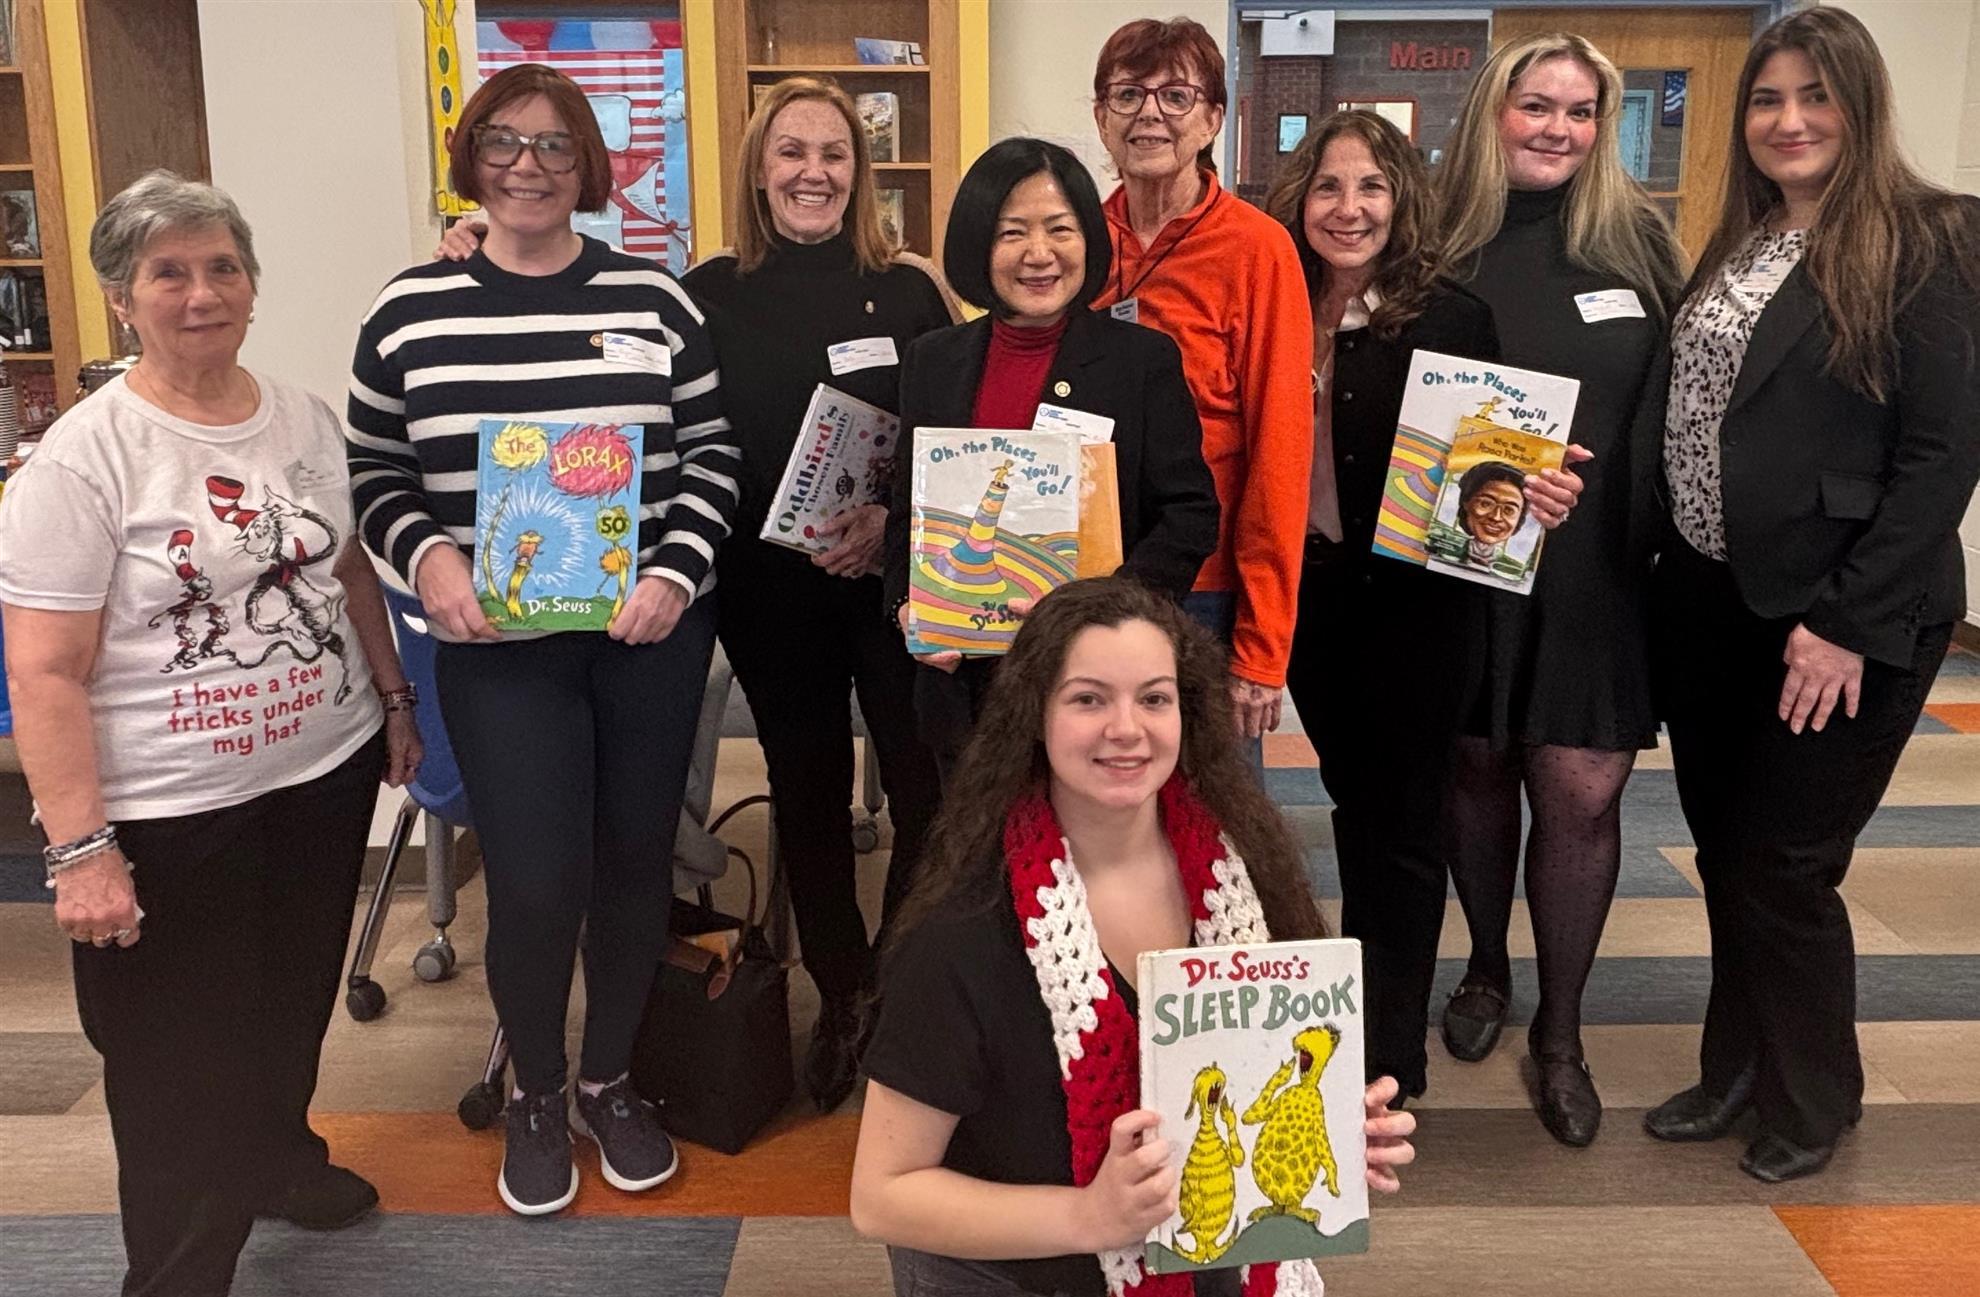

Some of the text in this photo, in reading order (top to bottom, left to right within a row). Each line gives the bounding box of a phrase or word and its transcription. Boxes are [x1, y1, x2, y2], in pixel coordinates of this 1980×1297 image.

[1390, 41, 1472, 70] Main
[1455, 371, 1479, 385] the
[1484, 371, 1529, 403] Places
[1508, 406, 1547, 422] You'll
[506, 439, 629, 476] The LORAX
[803, 461, 832, 513] Chosen
[825, 412, 850, 460] Family
[961, 440, 988, 454] the
[990, 436, 1038, 463] Places
[777, 404, 839, 533] Oddbird's
[1021, 463, 1059, 481] You'll
[1037, 475, 1072, 496] Go!
[601, 516, 627, 534] 50
[177, 547, 188, 560] A
[526, 596, 592, 616] Dr. Seuss
[969, 613, 996, 631] Dr.
[173, 663, 323, 708] I have a few
[167, 687, 326, 734] tricks under
[213, 717, 302, 756] my hat
[1180, 950, 1311, 988] Dr. Seuss's
[1151, 973, 1359, 1047] SLEEP BOOK
